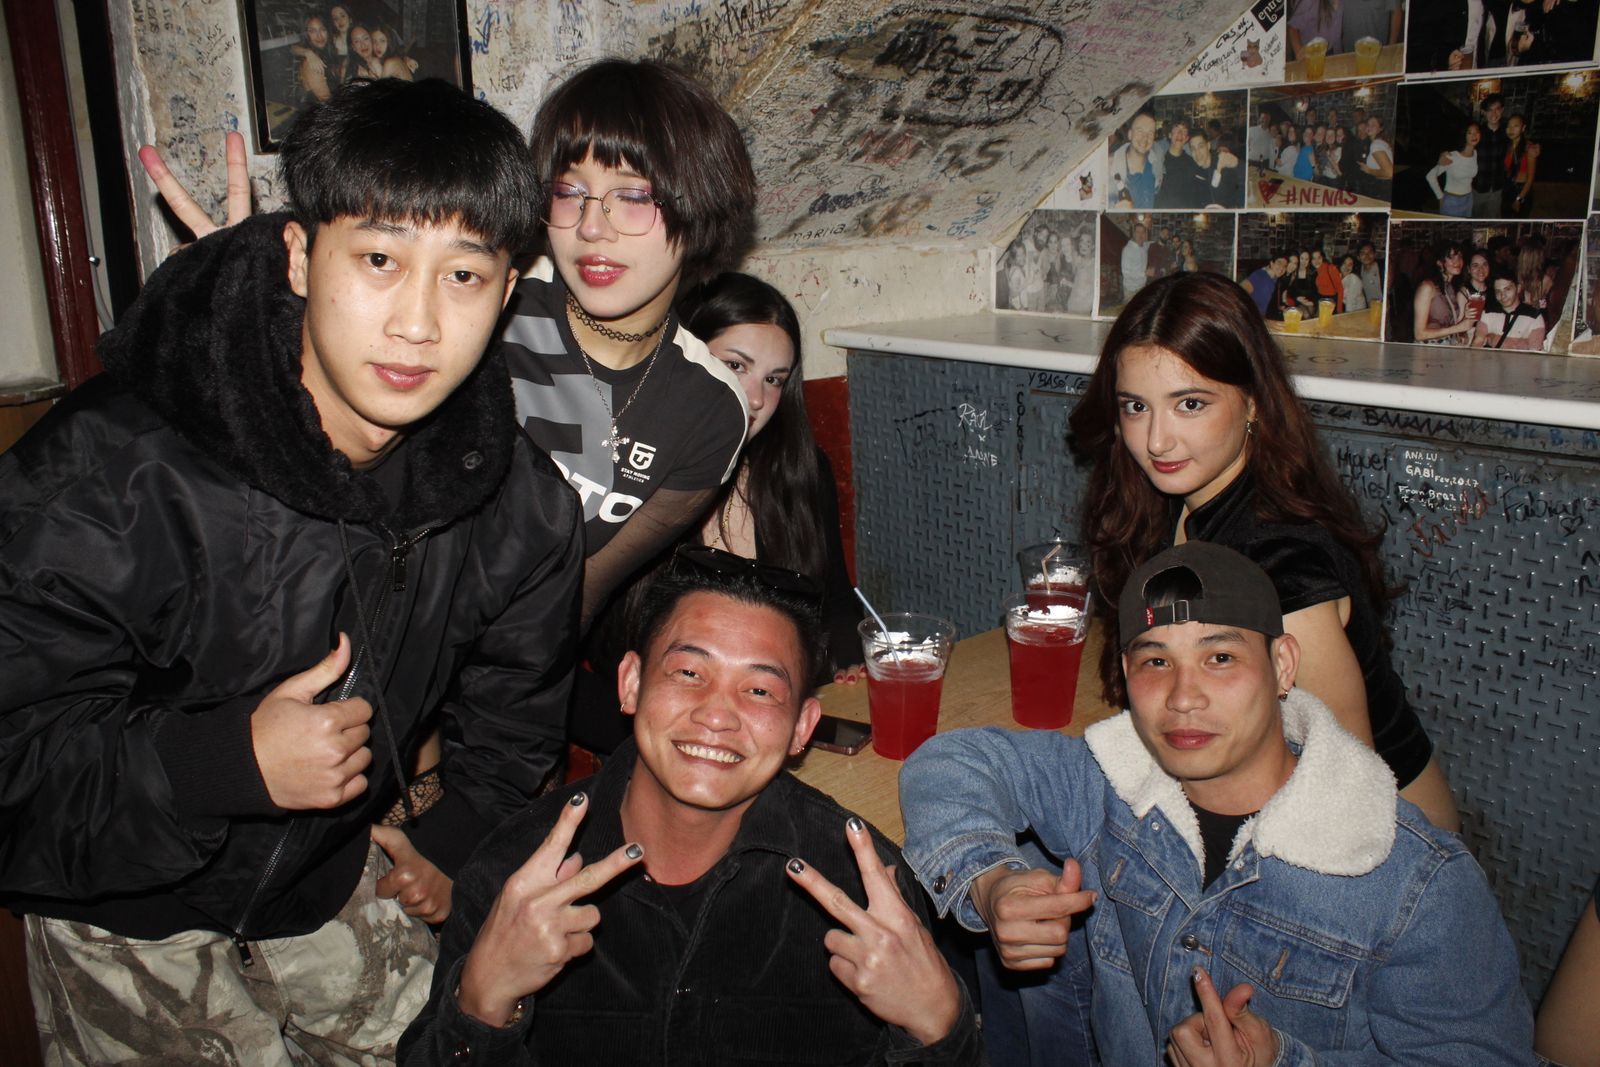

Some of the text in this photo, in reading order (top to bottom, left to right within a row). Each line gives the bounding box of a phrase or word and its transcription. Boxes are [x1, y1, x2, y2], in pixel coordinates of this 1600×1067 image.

[1280, 185, 1358, 206] #NENAS
[1405, 464, 1435, 478] GABI
[551, 456, 644, 523] TO
